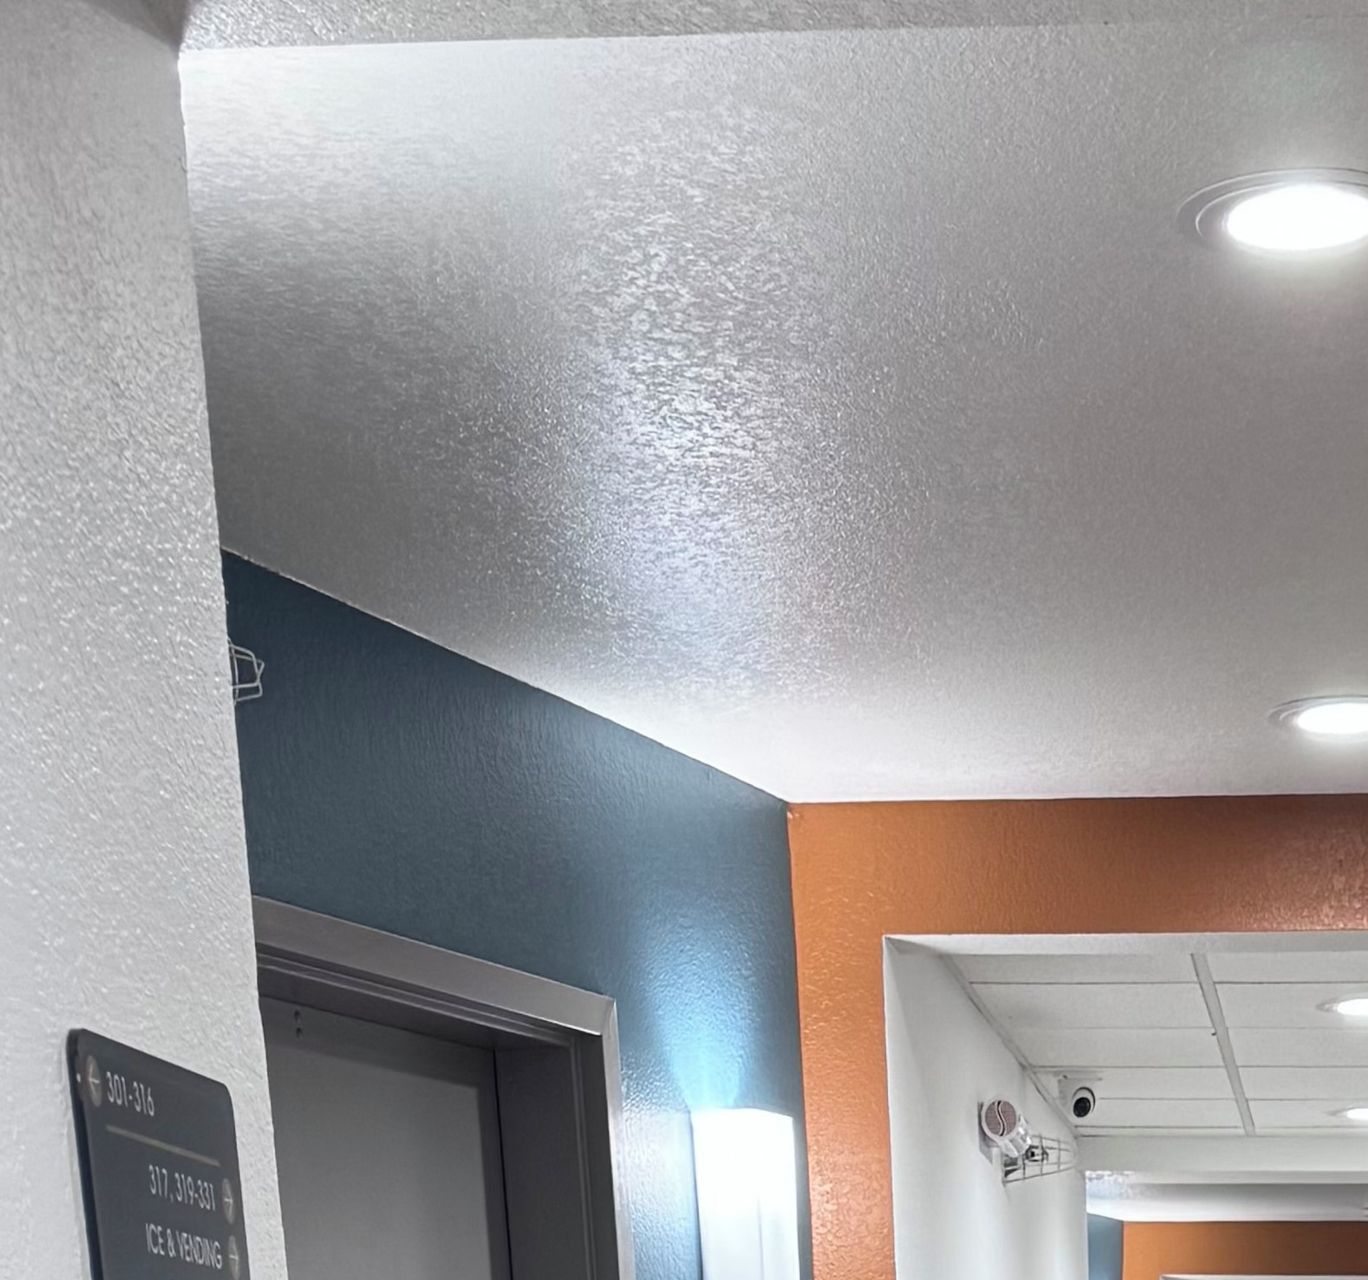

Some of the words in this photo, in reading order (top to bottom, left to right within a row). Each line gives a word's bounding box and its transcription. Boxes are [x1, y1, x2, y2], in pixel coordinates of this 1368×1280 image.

[106, 1071, 155, 1117] 301-316
[174, 1172, 216, 1212] 319-331
[145, 1223, 165, 1256] ICE
[166, 1228, 176, 1258] &
[176, 1230, 223, 1270] VENDING
